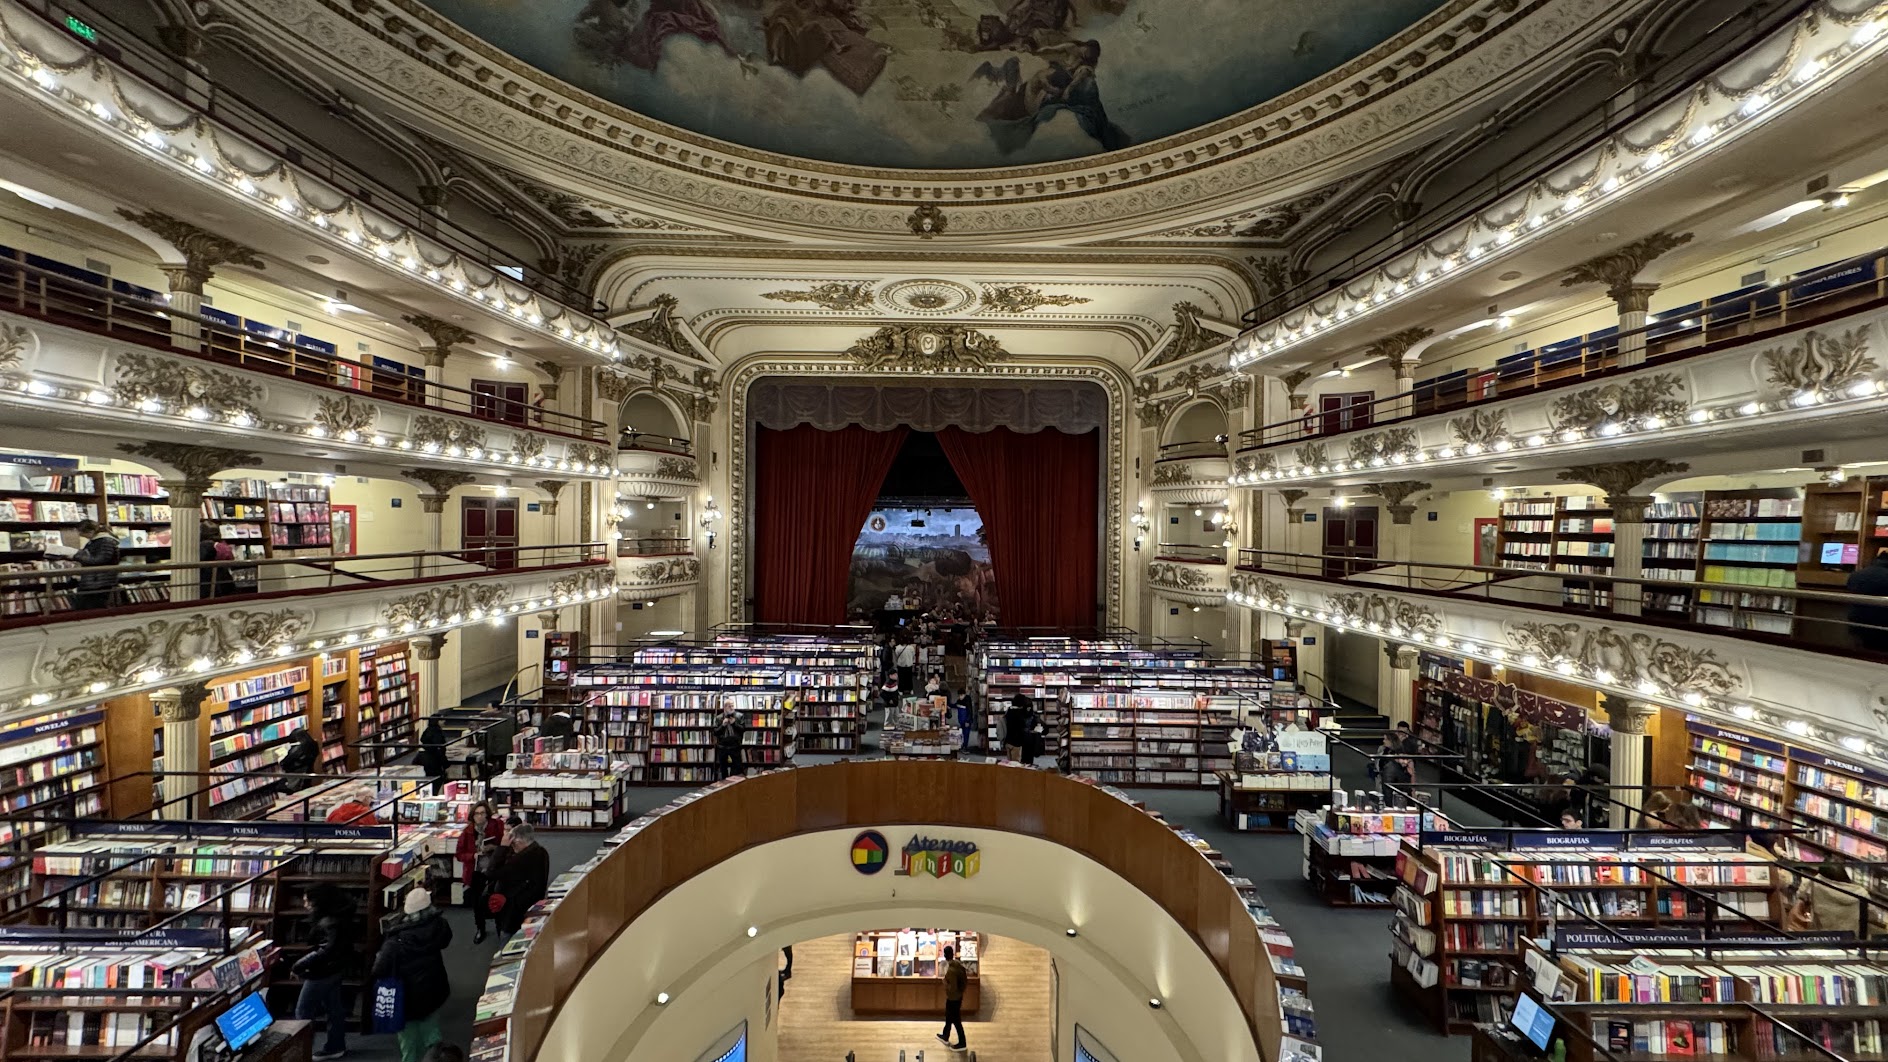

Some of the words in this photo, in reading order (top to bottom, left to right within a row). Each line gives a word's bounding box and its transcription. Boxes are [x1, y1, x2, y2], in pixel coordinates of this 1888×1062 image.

[13, 457, 42, 465] COCINA
[35, 720, 70, 734] NOVELAS
[1717, 730, 1750, 743] JUVENILES
[1824, 758, 1865, 774] JUVENILES
[232, 827, 259, 835] POESIA
[334, 829, 361, 837] POESIA
[1443, 835, 1488, 843] BIOGRAFÍAS
[905, 834, 977, 856] Ateneo
[904, 853, 980, 874] Junior
[1565, 934, 1611, 944] POLITICA
